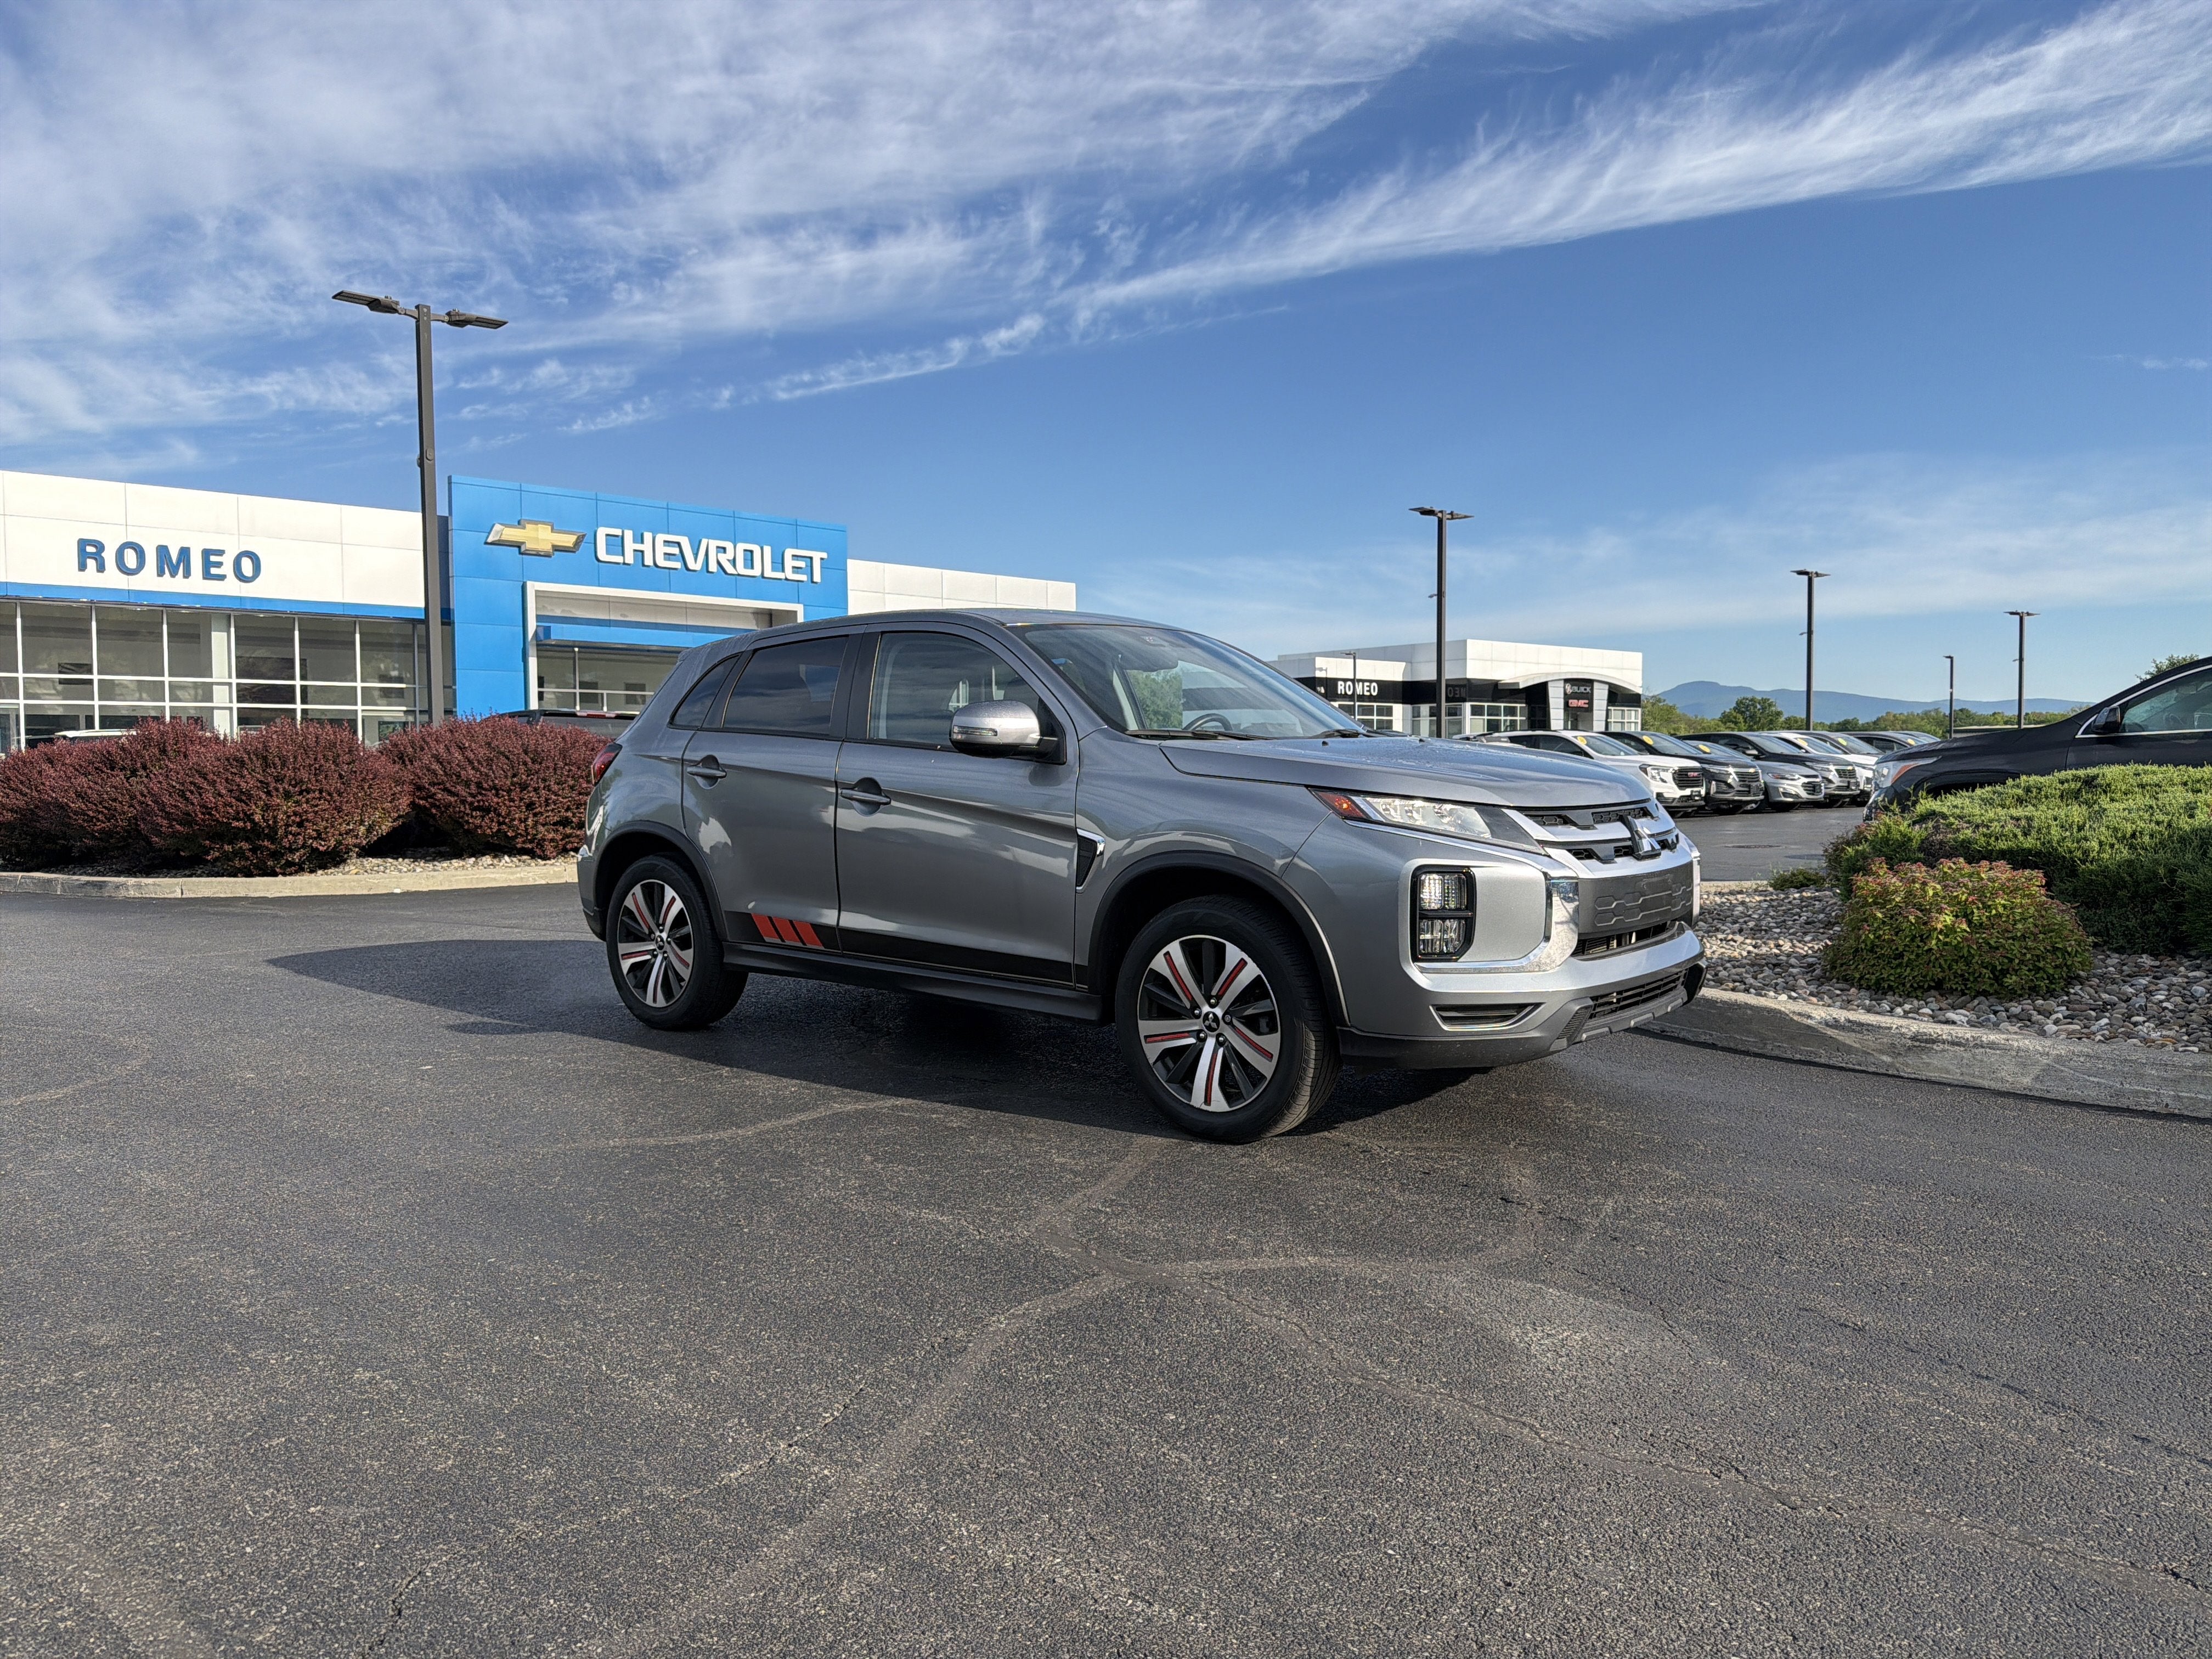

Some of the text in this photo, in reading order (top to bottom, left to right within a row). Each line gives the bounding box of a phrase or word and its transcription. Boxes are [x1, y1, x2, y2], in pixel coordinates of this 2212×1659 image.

[77, 538, 262, 584] ROMEO
[595, 527, 828, 584] CHEVROLET
[1338, 681, 1378, 696] ROMEO
[1568, 699, 1589, 708] GMC
